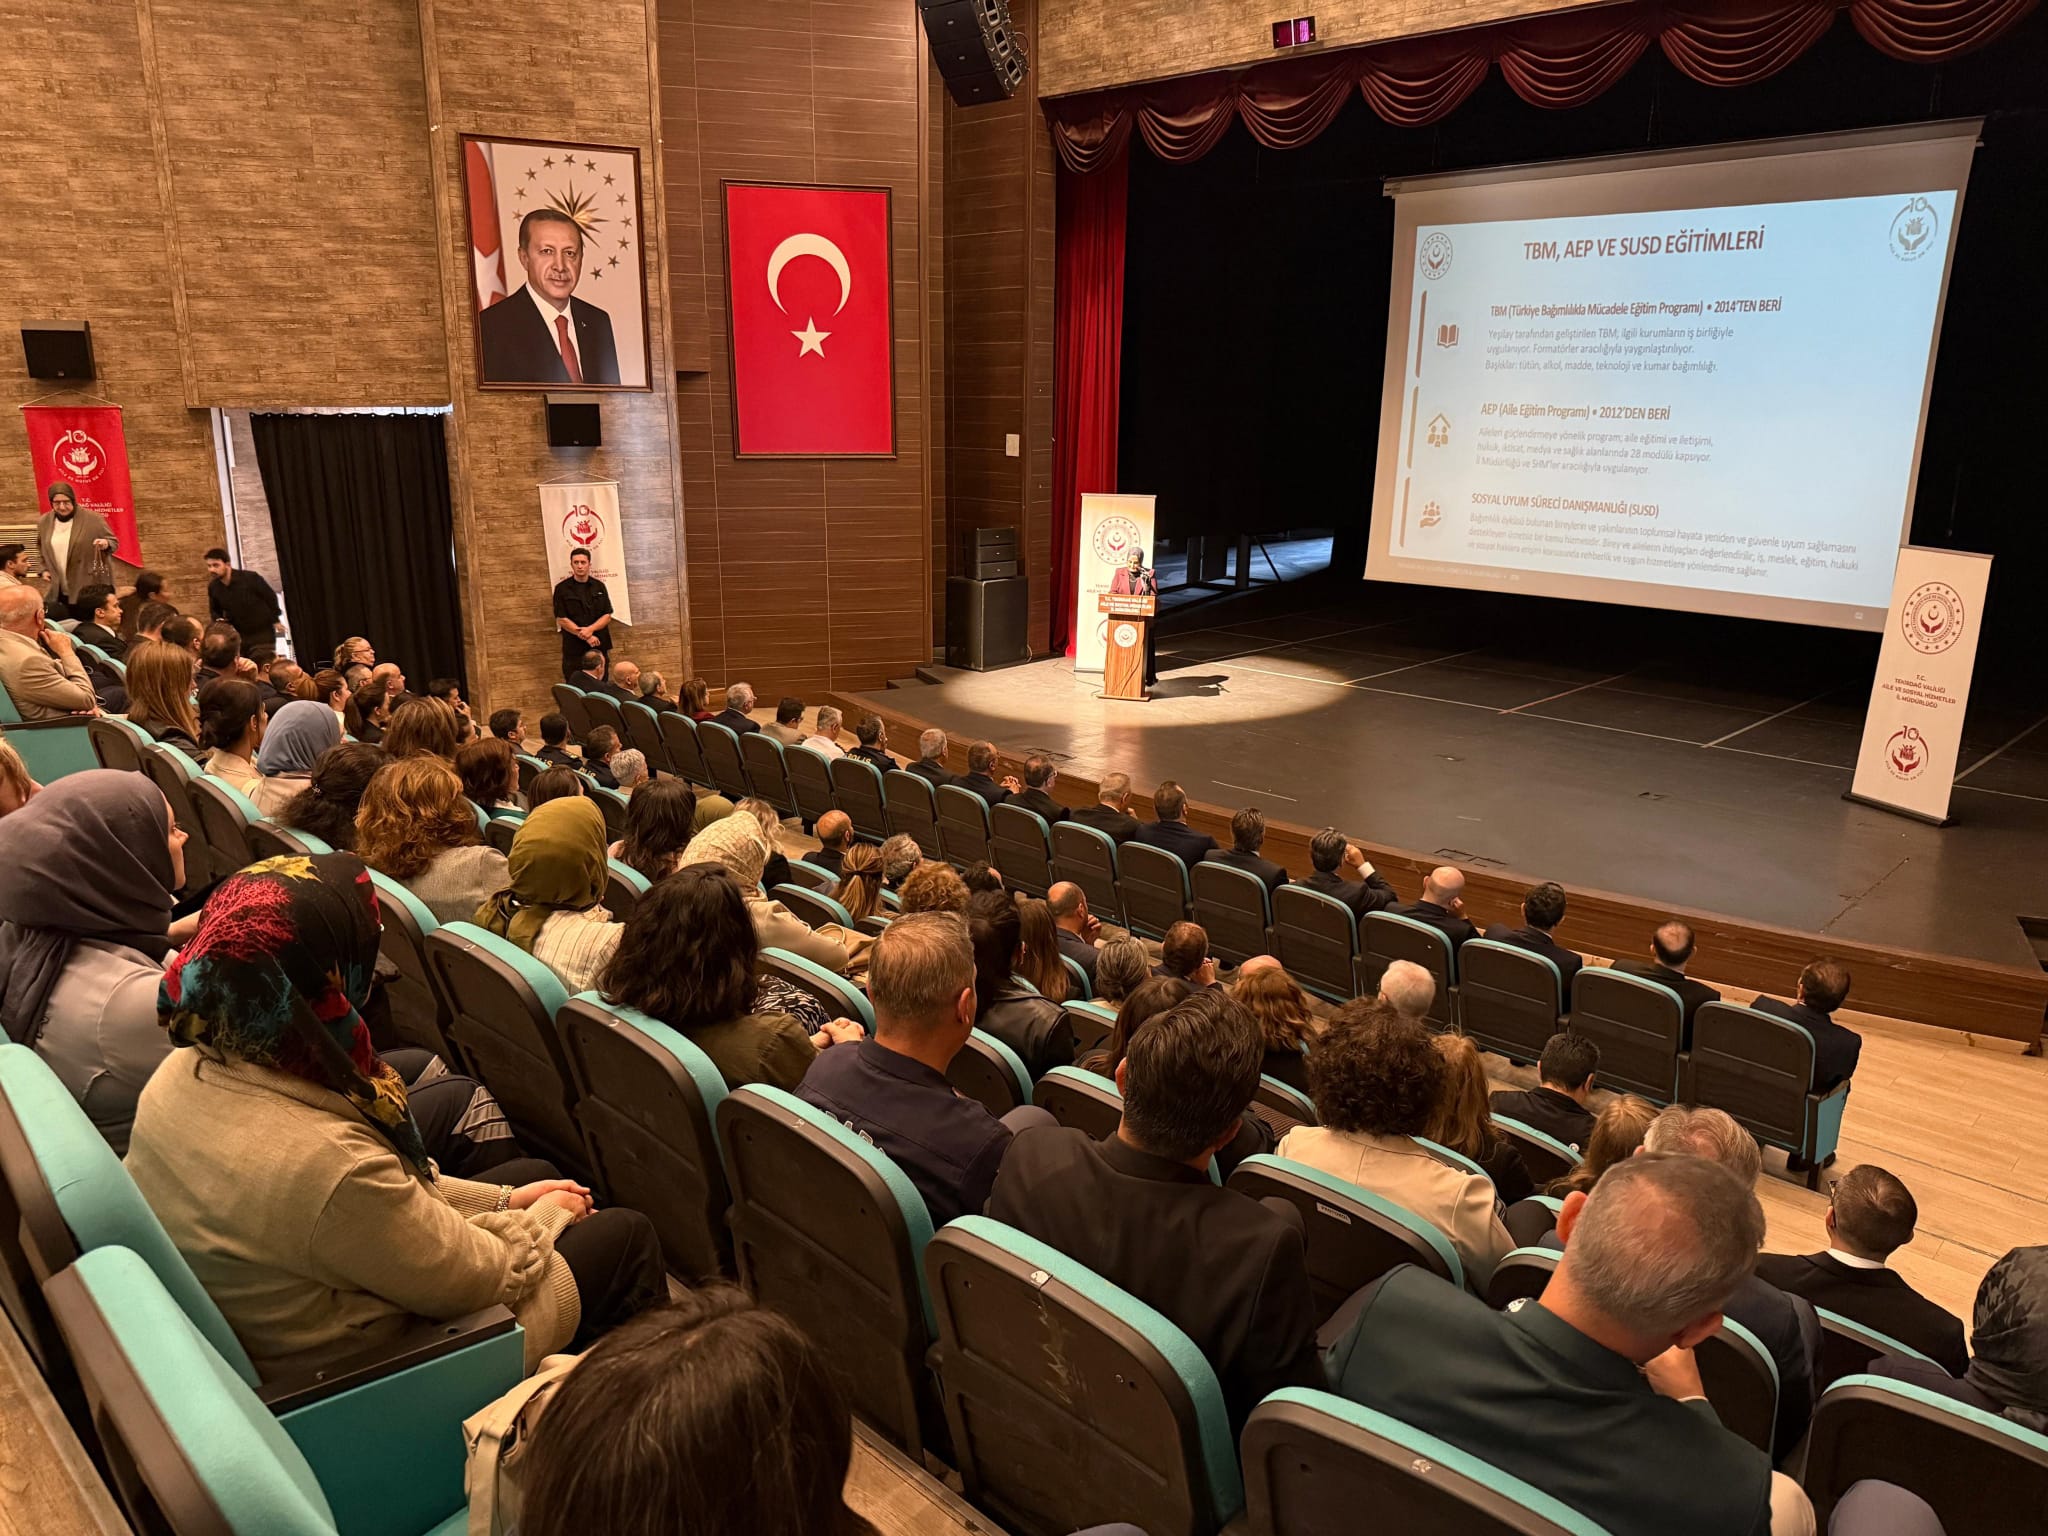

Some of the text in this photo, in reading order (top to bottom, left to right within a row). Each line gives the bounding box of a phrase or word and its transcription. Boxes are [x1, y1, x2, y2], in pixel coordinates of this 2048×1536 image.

[1524, 224, 1765, 262] TBM, AEP VE SUSD EĞİTİMLERİ
[1491, 305, 1507, 317] TBM
[1509, 305, 1539, 319] (Türkiye
[1587, 303, 1629, 315] Mücadele
[1631, 302, 1657, 317] Eğitim
[1659, 300, 1703, 316] Programı)
[1759, 296, 1782, 312] BERİ
[1481, 404, 1497, 415] AEP
[1500, 403, 1518, 417] (Aile
[1520, 404, 1546, 418] Eğitim
[1548, 405, 1589, 420] Programı)
[1648, 405, 1671, 420] BERİ
[1471, 493, 1501, 505] SOSYAL
[1503, 496, 1529, 507] UYUM
[1531, 495, 1561, 510] SÜRECİ
[1629, 504, 1659, 519] (SUSD)
[1903, 688, 1924, 697] SOSYAL
[1925, 692, 1956, 704] HİZMETLER
